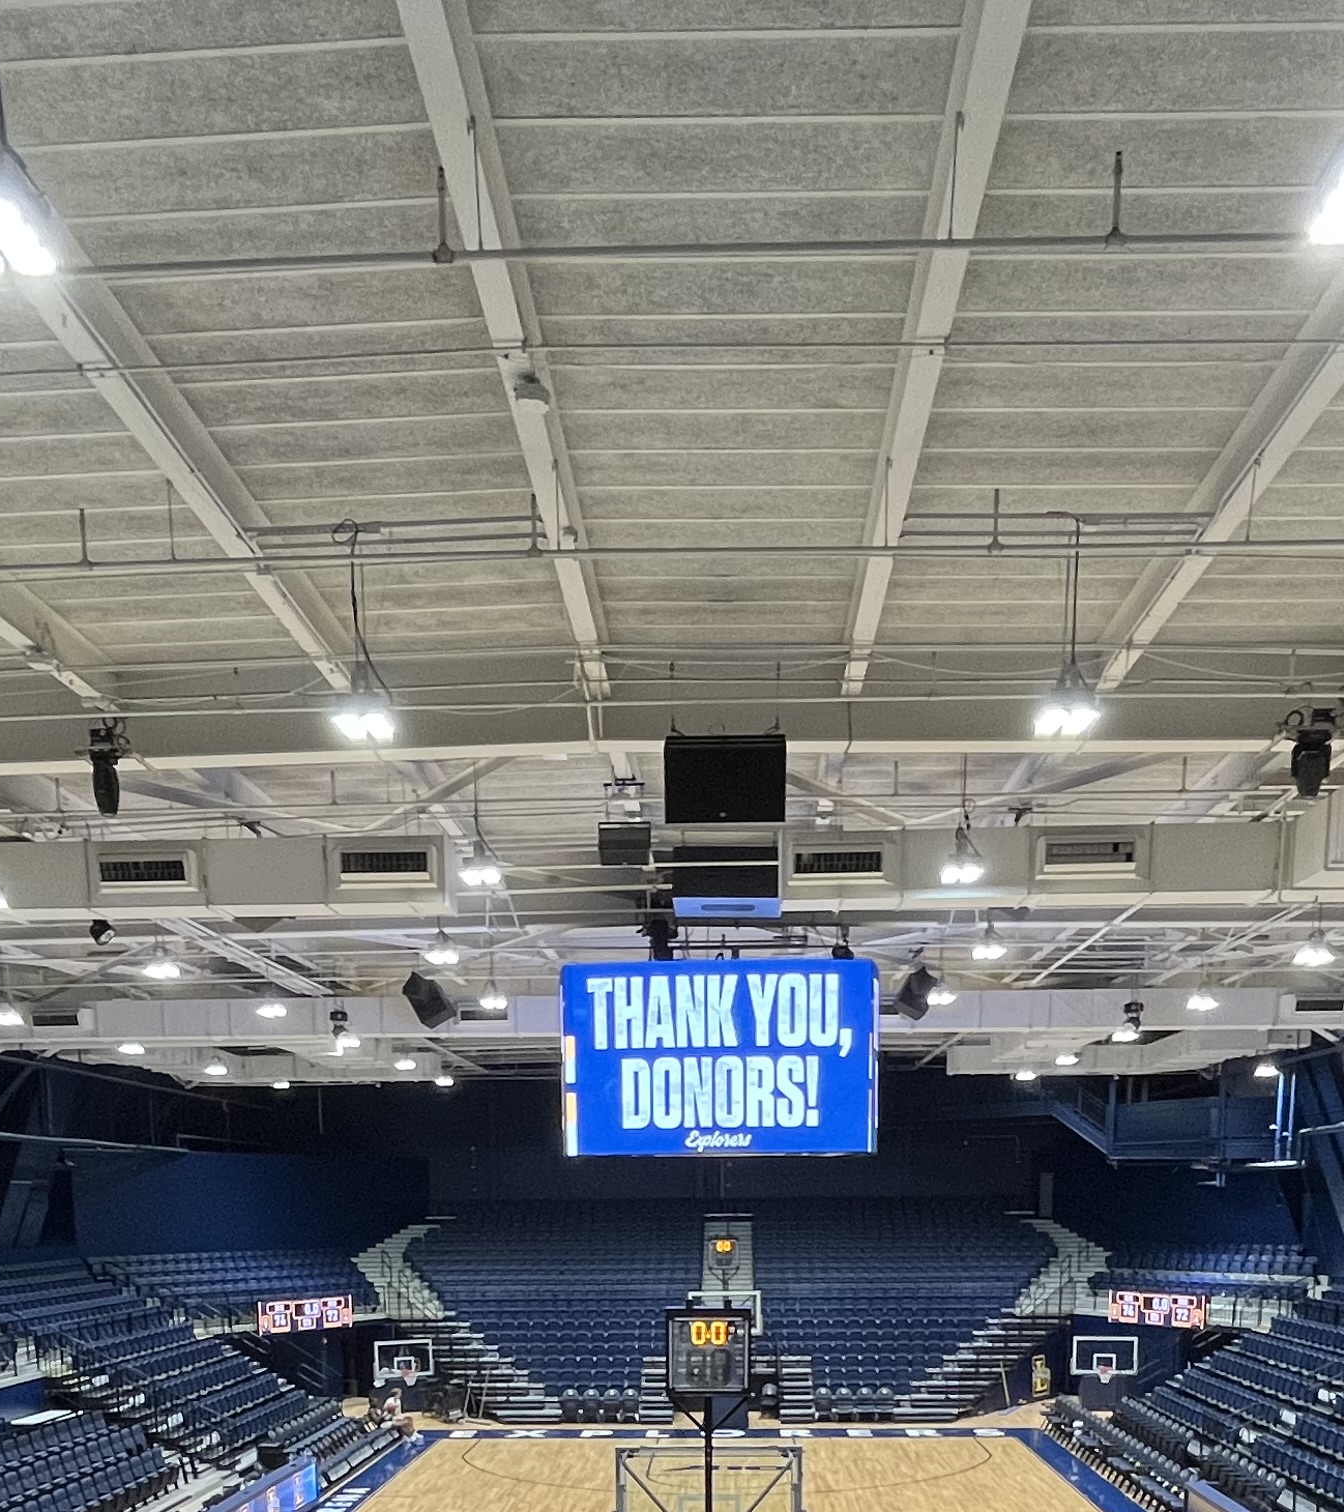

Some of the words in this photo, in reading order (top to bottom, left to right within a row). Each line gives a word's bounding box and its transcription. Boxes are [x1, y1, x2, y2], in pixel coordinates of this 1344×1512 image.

[586, 974, 739, 1050] THANK
[746, 973, 853, 1057] YOU,
[621, 1055, 819, 1130] DONORS!
[684, 1130, 752, 1153] Explorers
[449, 1428, 1005, 1438] EXPLORERS
